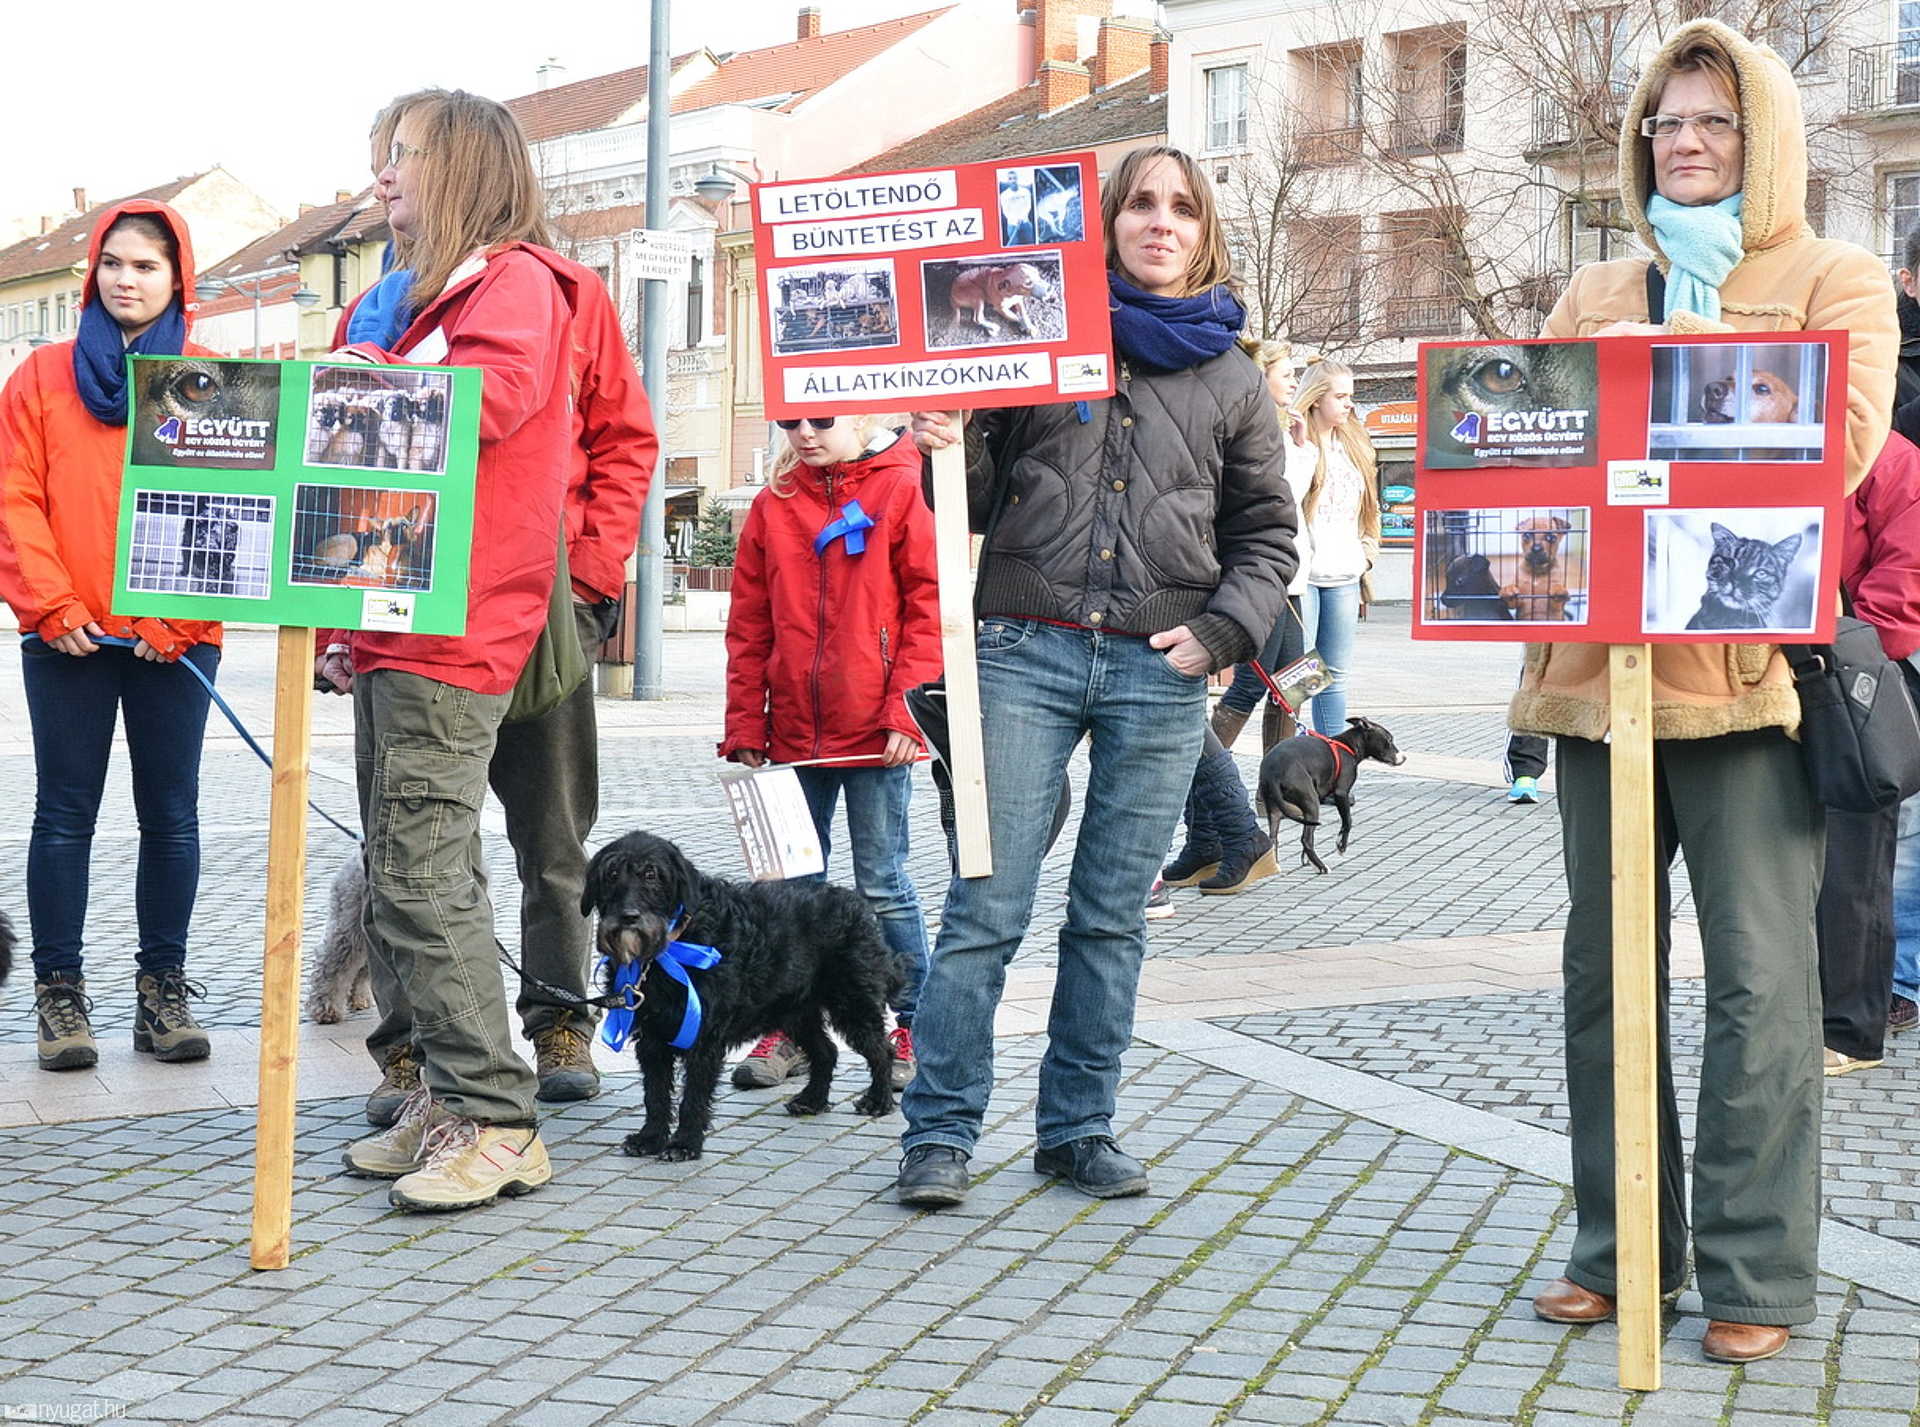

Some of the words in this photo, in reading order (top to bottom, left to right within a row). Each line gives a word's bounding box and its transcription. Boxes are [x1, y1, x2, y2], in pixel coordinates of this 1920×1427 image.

[779, 178, 942, 214] LETÖLTENDŐ
[793, 218, 938, 251] BÜNTETÉST
[946, 217, 977, 238] AZ
[803, 361, 1030, 395] ÁLLATKÍNZÓKNAK
[185, 416, 271, 438] EGYÜTT
[1487, 407, 1590, 432] EGYÜTT
[1487, 433, 1509, 444] EGY
